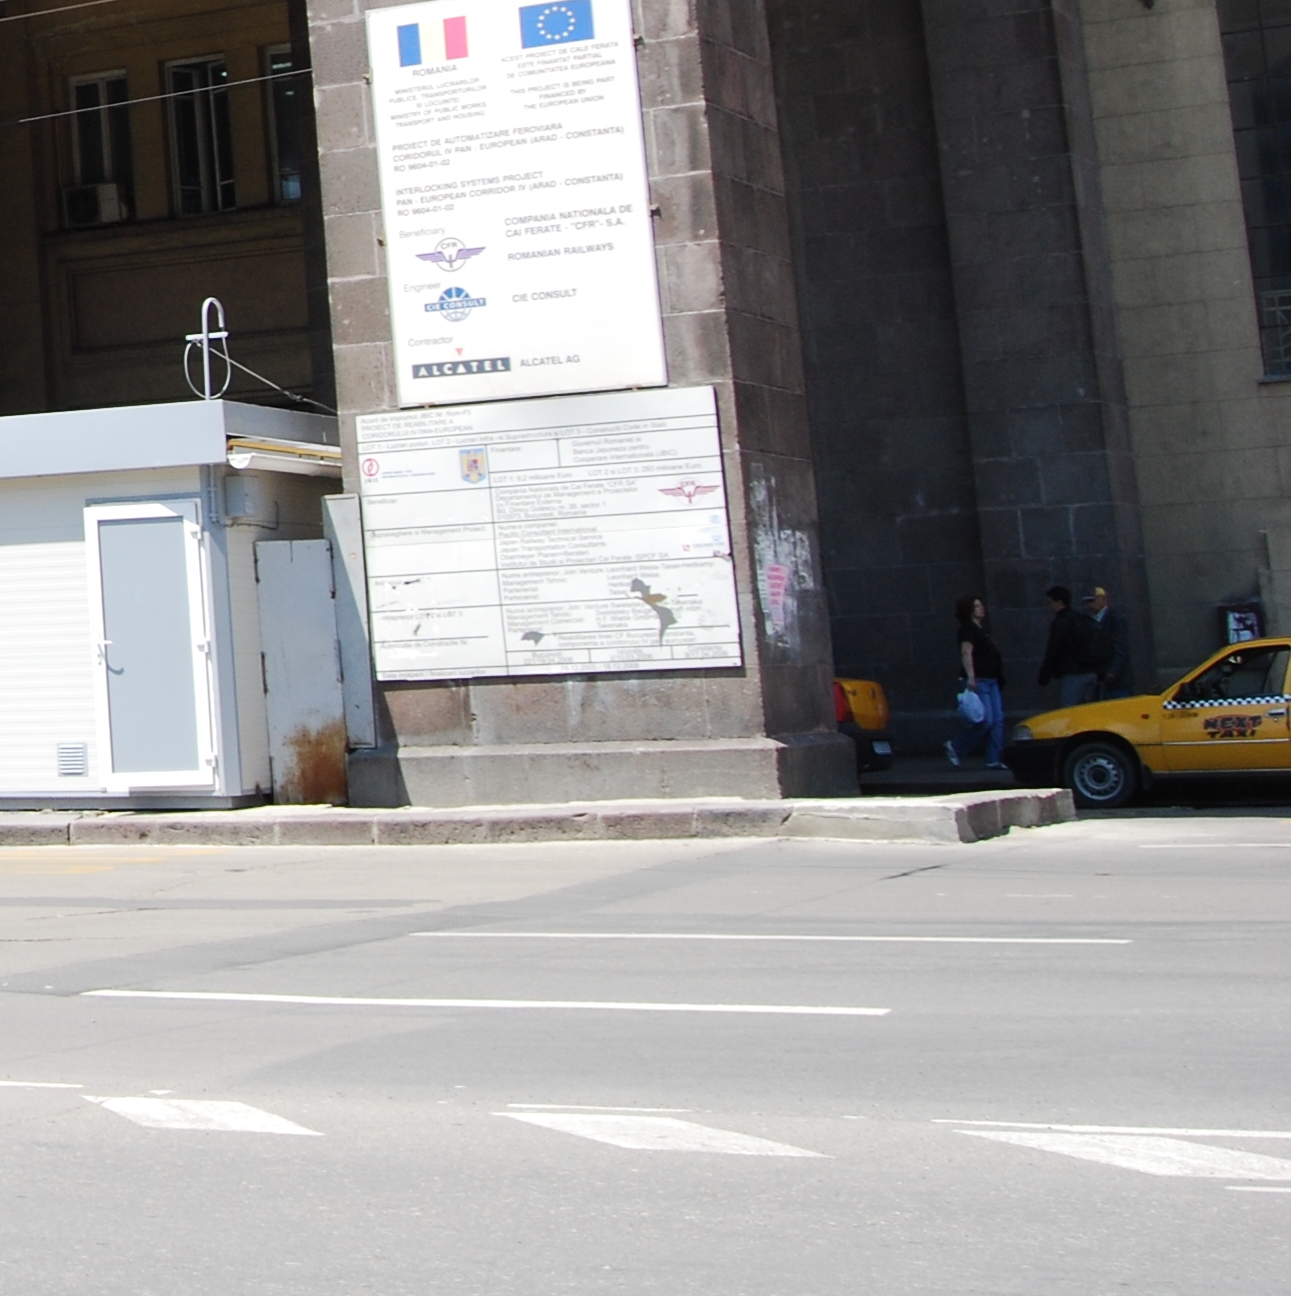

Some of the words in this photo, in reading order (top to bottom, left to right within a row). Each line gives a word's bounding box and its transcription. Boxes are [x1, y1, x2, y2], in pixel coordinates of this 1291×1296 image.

[412, 64, 457, 76] ROMANIA
[391, 140, 427, 150] PROIECT
[444, 129, 510, 143] AUTOMATIZARE
[512, 122, 562, 134] FEROVIARA
[392, 149, 442, 162] CORIDORUL
[479, 138, 527, 150] EUROPEAN
[530, 133, 557, 143] (ARAD
[565, 126, 624, 139] CONSTANTA)
[395, 181, 457, 195] INTERLOCKING
[459, 176, 500, 187] SYSTEMS
[502, 170, 542, 181] PROJECT
[419, 192, 466, 203] EUROPEAN
[468, 185, 515, 197] CORRIDOR
[529, 180, 556, 190] (ARAD
[564, 173, 623, 185] CONSTANTA)
[504, 213, 556, 225] COMPANIA
[559, 206, 616, 218] NATIONALA
[398, 227, 445, 238] Beneficiary
[524, 223, 561, 234] FERATE
[507, 248, 560, 260] ROMANIAN
[563, 242, 613, 254] RAILWAYS
[403, 282, 440, 293] Engineer
[530, 288, 576, 300] CONSULT
[425, 302, 440, 310] CIE
[442, 298, 485, 308] CONSULT
[407, 336, 453, 347] Contractor
[519, 356, 563, 366] ALCATEL
[417, 359, 506, 376] ALCATEL
[1203, 715, 1262, 730] NEXT
[1206, 730, 1256, 738] TAXI
